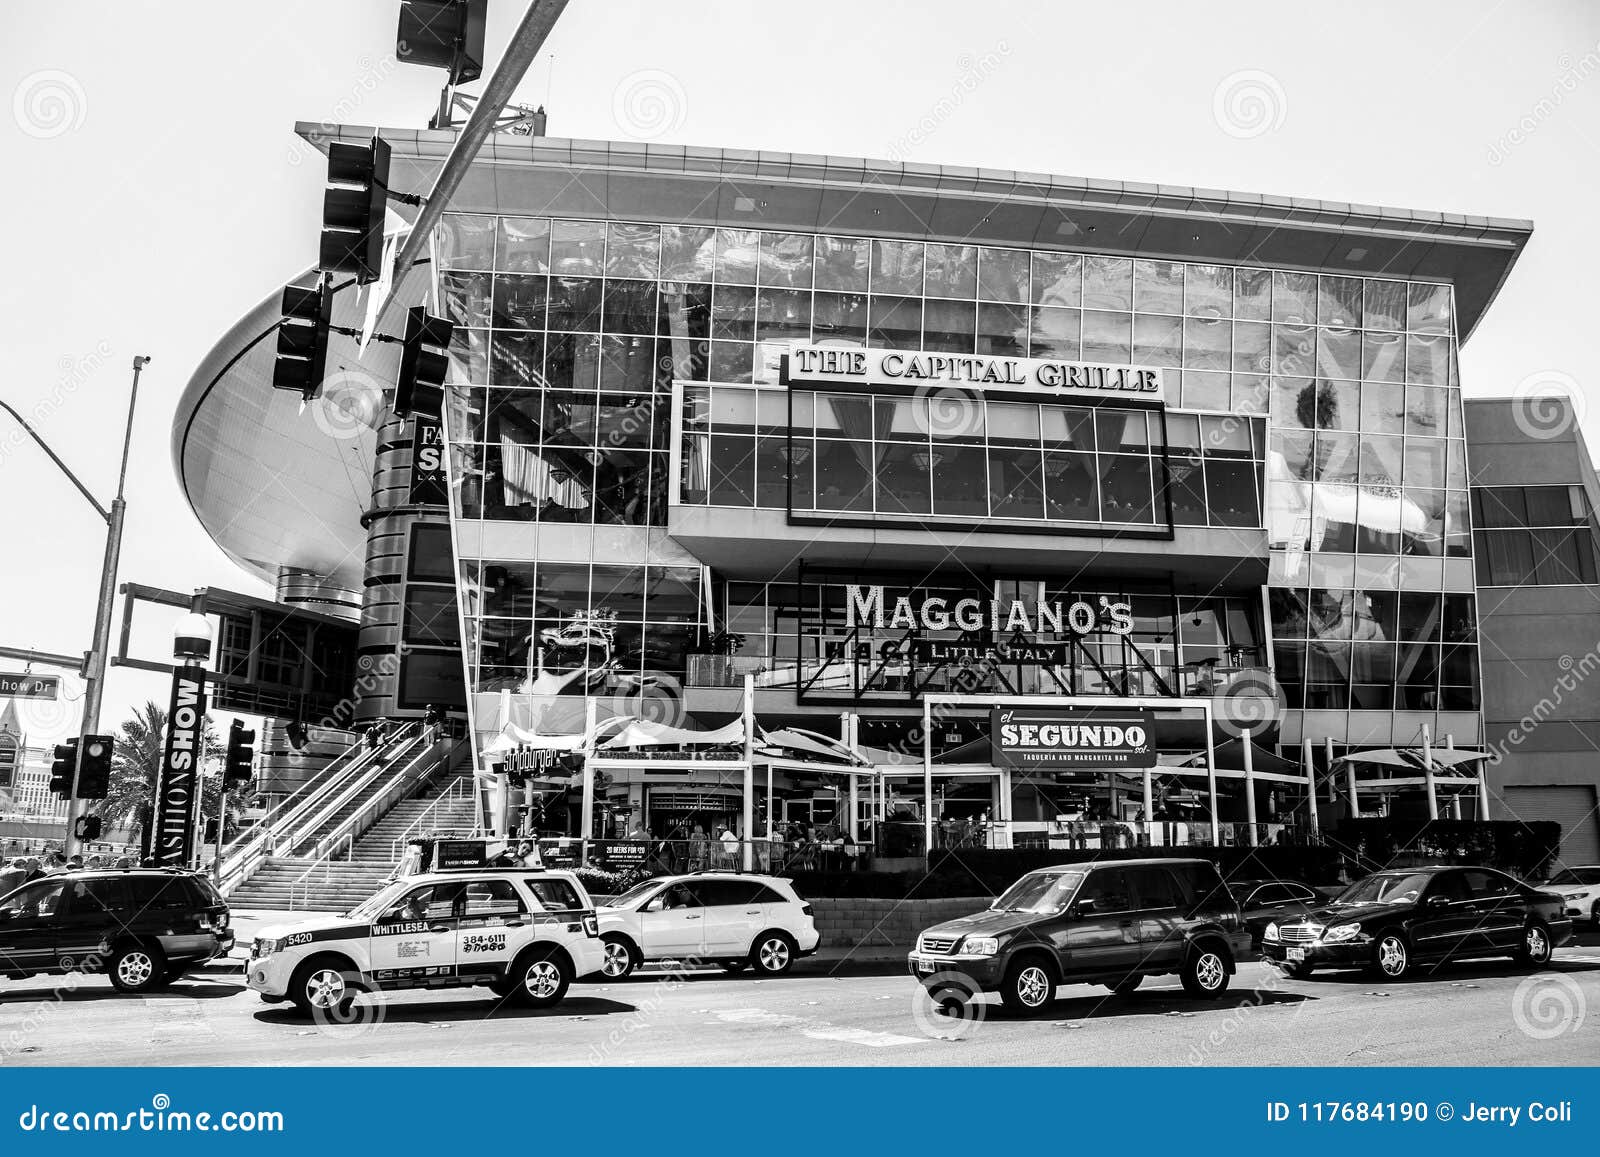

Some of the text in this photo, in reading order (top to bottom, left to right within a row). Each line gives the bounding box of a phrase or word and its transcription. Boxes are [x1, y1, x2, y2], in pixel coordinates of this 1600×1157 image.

[796, 348, 1160, 393] THE CAPITAL GRILLE
[420, 426, 444, 445] FA
[418, 447, 447, 471] S
[845, 584, 1135, 635] MAGGIANO'S
[931, 643, 996, 660] LITTLE
[1006, 644, 1057, 661] ITALY
[0, 679, 51, 692] how Dr
[1000, 710, 1014, 724] el
[1000, 724, 1146, 747] SEGUNDO
[1074, 754, 1113, 762] MARGARITA
[160, 678, 200, 866] ASHIONSHOW
[613, 846, 628, 854] BEERS
[372, 921, 430, 936] WHITTLESEA
[288, 932, 313, 945] 5420
